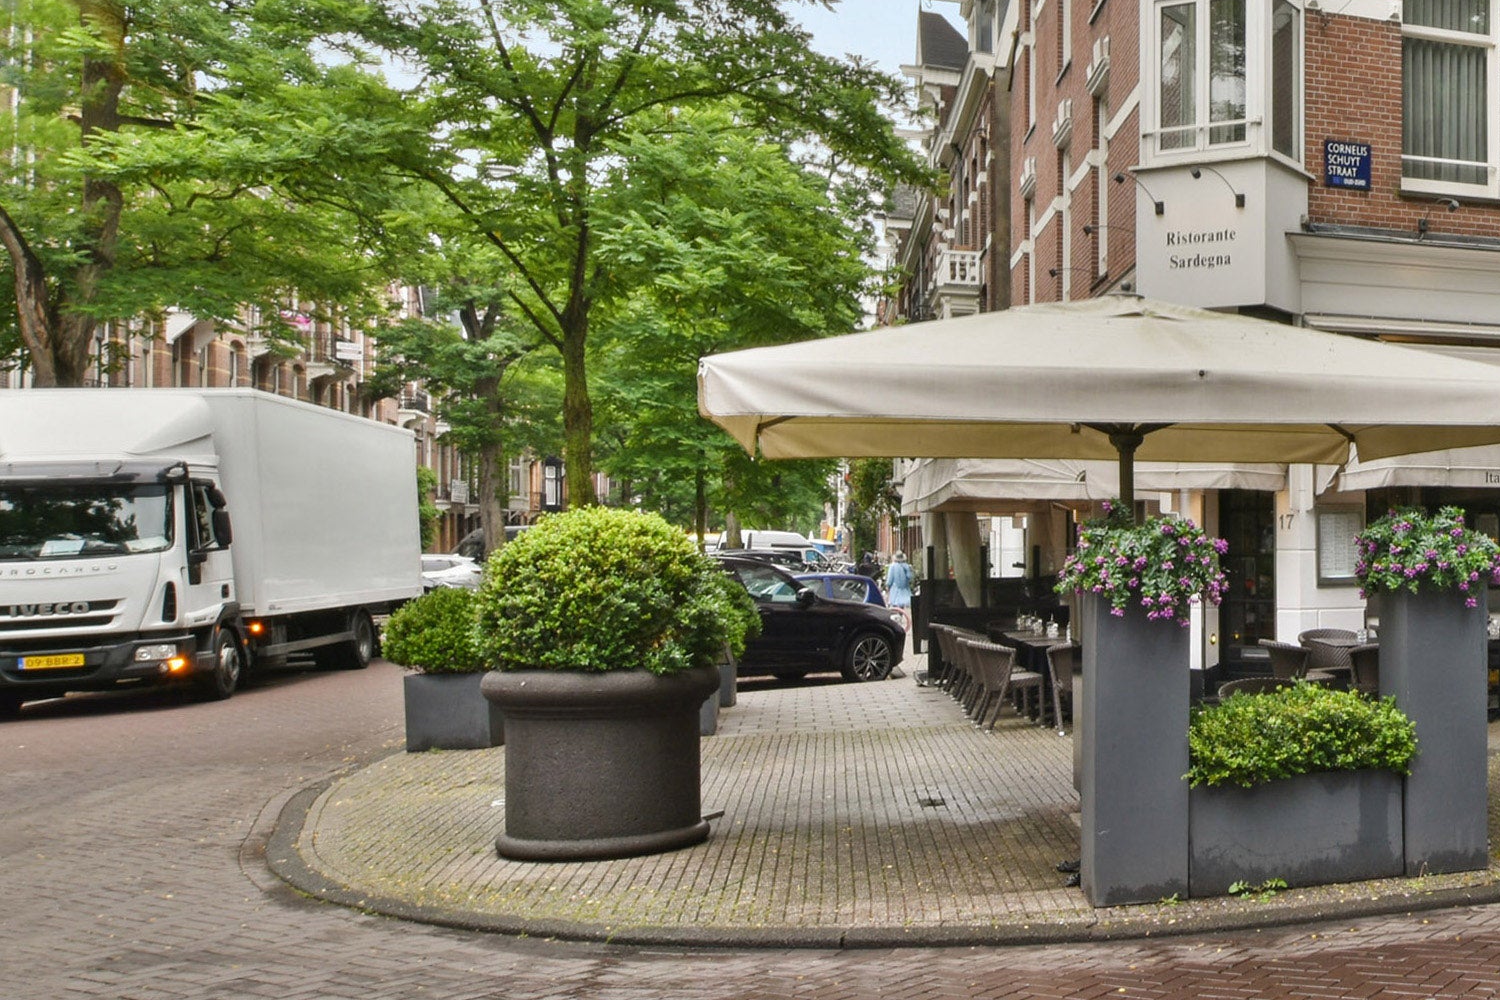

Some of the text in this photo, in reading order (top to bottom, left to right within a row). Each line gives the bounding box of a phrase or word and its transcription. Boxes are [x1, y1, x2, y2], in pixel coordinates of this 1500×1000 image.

[1327, 142, 1368, 156] CORNELIS
[1327, 154, 1361, 167] SCHUYT
[1327, 165, 1357, 177] STRAAT
[1166, 228, 1236, 246] Ristorante
[1169, 253, 1231, 269] Sardegna
[1279, 514, 1294, 530] 17
[9, 601, 90, 618] IVECO
